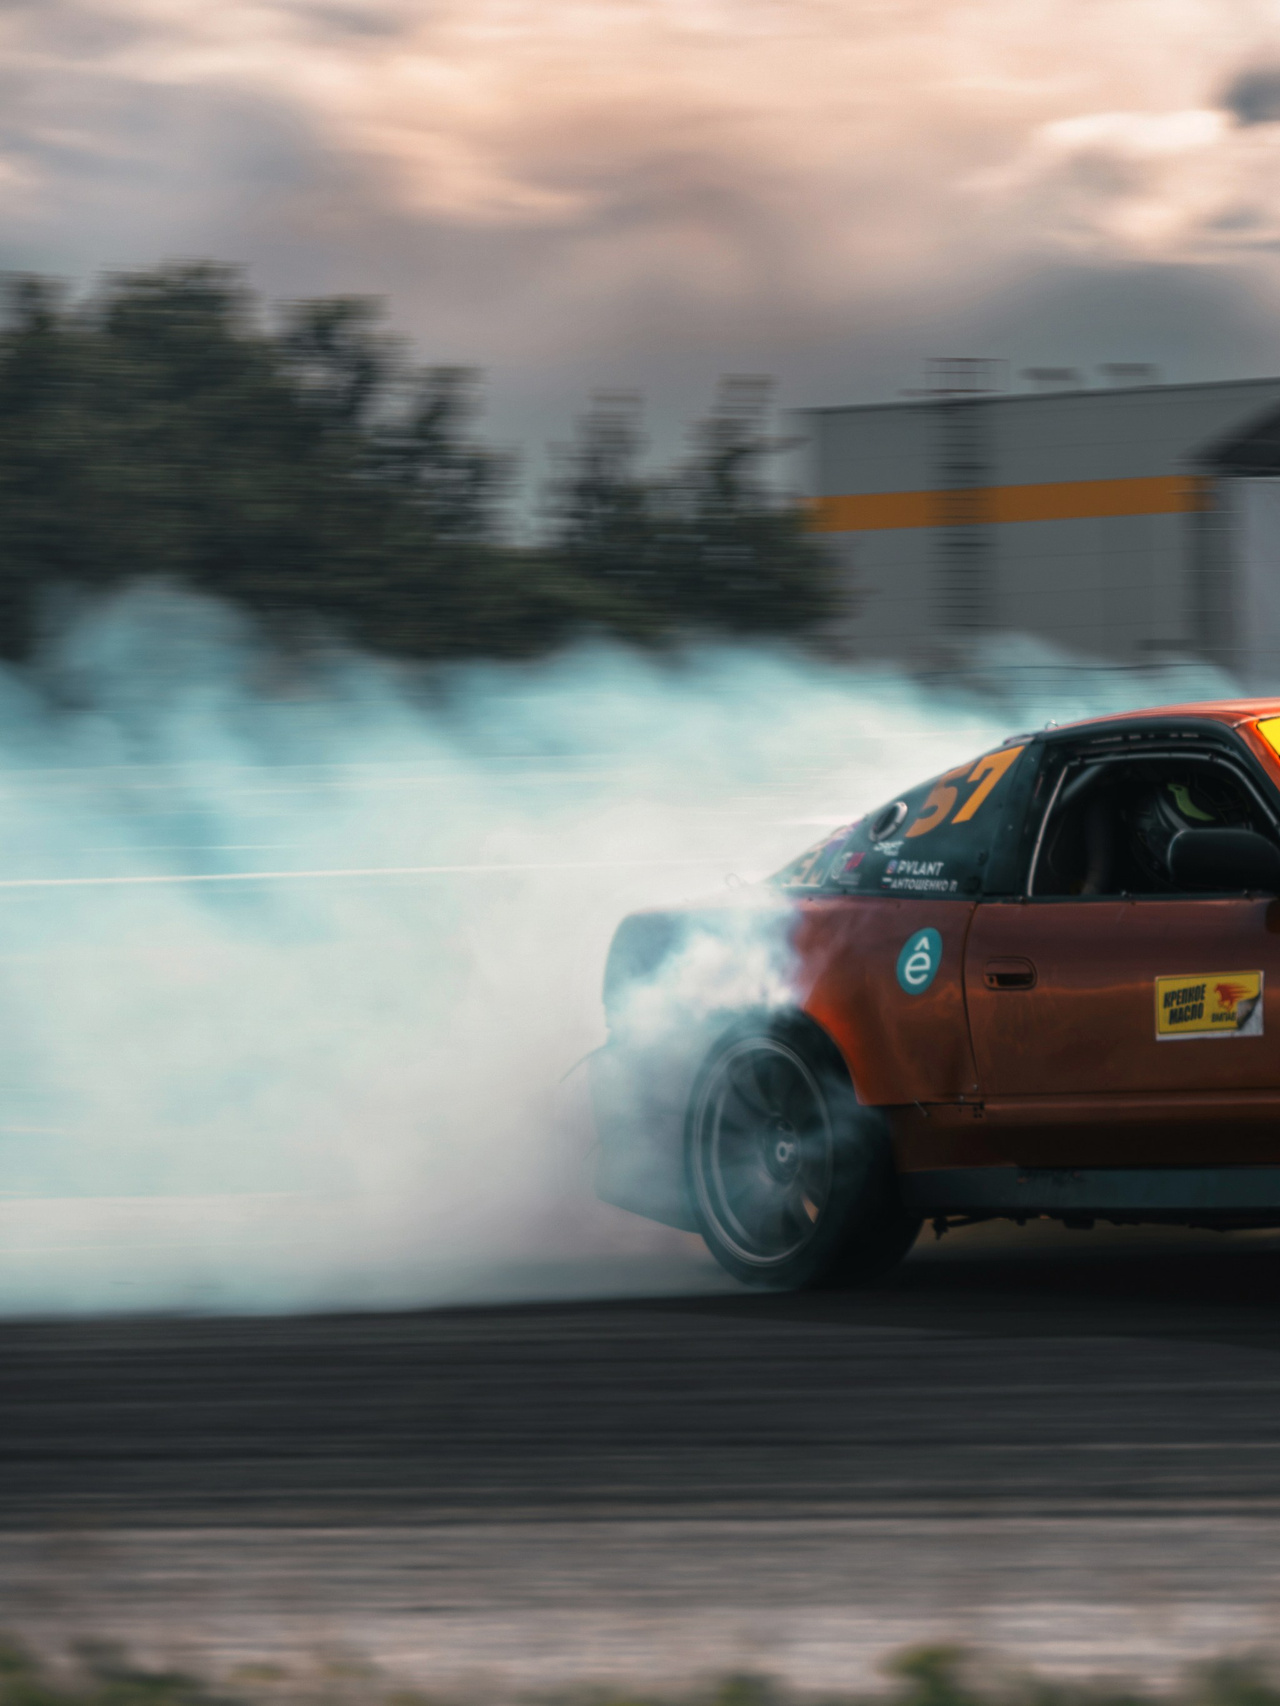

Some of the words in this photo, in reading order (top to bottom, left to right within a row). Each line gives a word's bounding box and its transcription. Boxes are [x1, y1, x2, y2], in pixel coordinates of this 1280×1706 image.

[904, 746, 1025, 837] 57
[1163, 984, 1207, 1008] КРЕПКОЕ
[1169, 1003, 1204, 1024] МАСЛО
